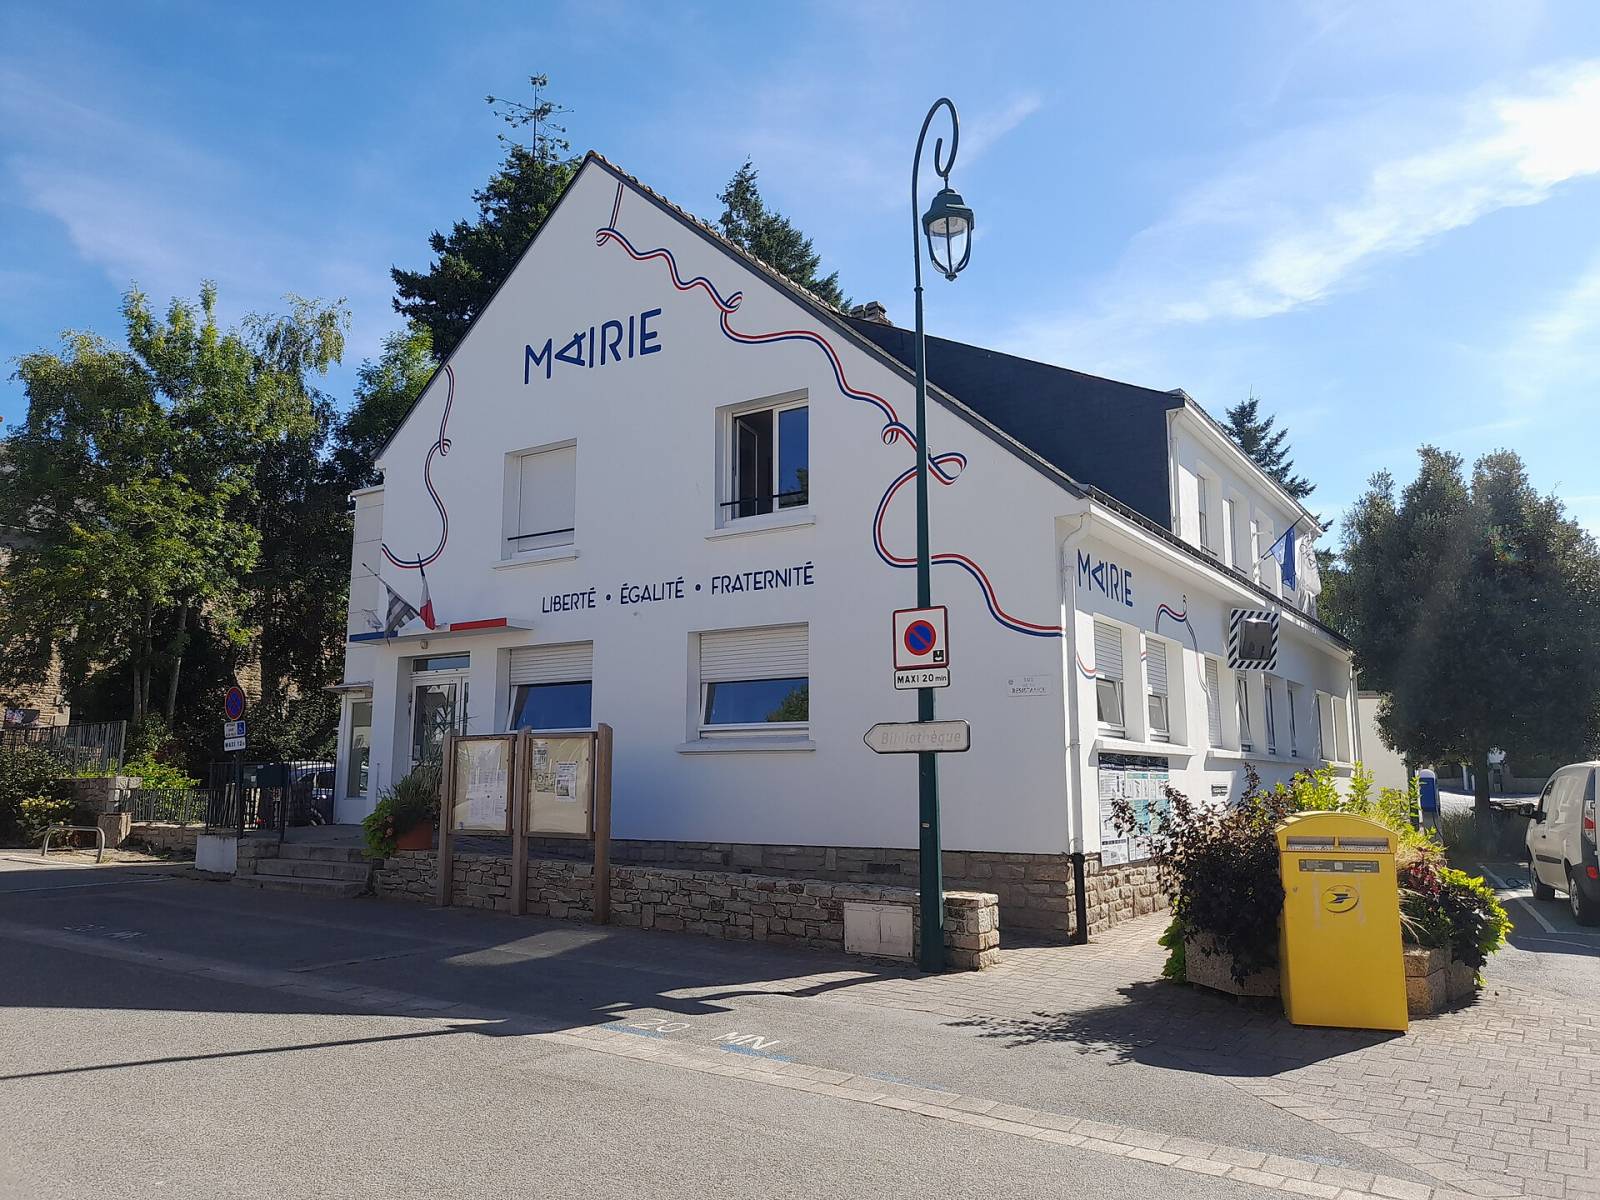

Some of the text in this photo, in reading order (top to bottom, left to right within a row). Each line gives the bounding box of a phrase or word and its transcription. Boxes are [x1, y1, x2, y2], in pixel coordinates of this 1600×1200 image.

[524, 307, 662, 385] MAIRIE
[541, 561, 815, 614] LIBERTÉ ÉGALITÉ FRATERNITÉ
[1077, 548, 1133, 608] MAIRIE
[897, 674, 919, 684] MAXI
[922, 673, 934, 683] 20
